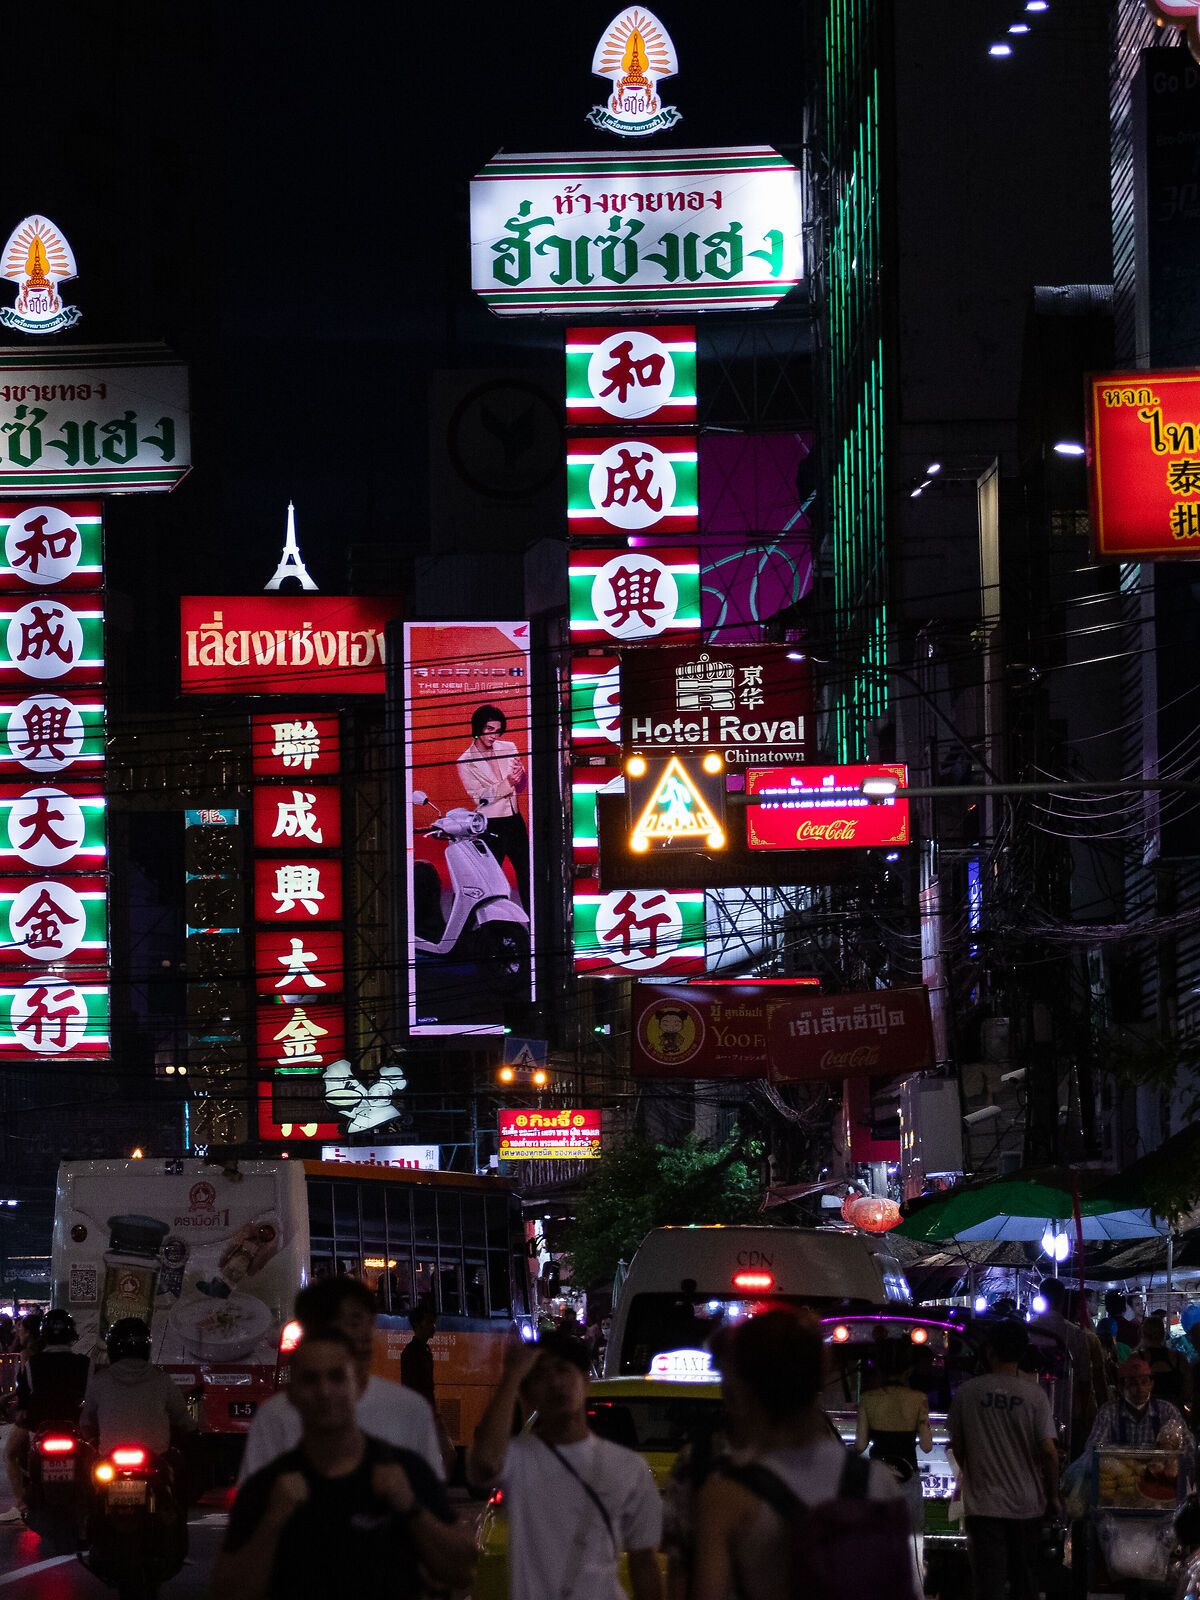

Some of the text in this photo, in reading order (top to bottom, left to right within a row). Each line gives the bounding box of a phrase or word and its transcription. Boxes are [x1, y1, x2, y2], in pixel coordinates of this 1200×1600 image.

[553, 183, 722, 215] ห้างขายทอง
[489, 199, 785, 286] ฮั่วเซ่งเฮง
[1104, 388, 1159, 406] หจก.
[598, 341, 673, 960] 和成興行
[739, 665, 765, 710] 京华
[631, 715, 805, 743] Hotel Royal
[724, 749, 805, 763] Chinatown
[796, 819, 859, 841] Coca-Cola
[270, 720, 328, 1138] 聯成興大金
[819, 1045, 881, 1070] Coca-Cola
[233, 1404, 252, 1415] 1-5
